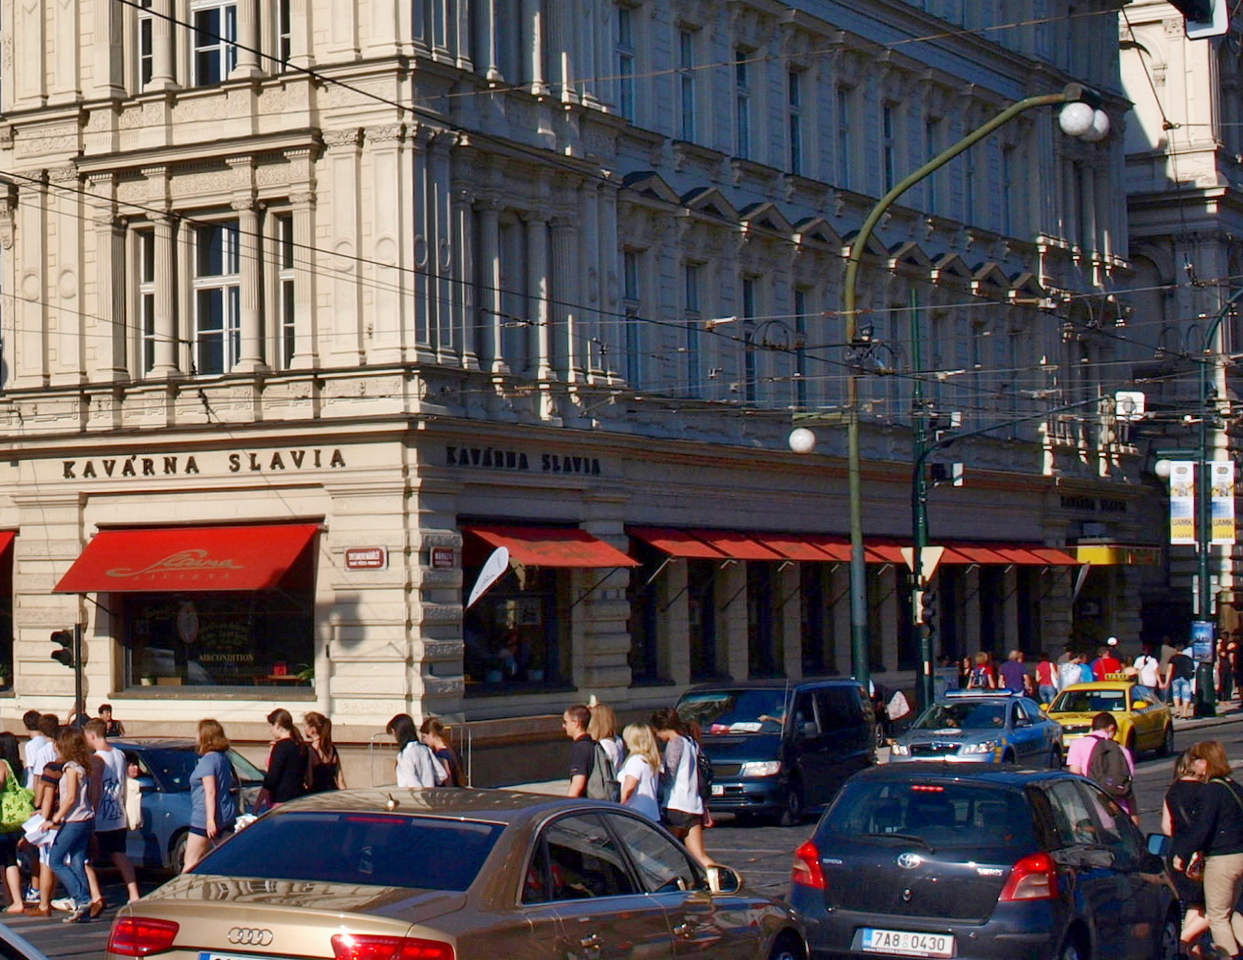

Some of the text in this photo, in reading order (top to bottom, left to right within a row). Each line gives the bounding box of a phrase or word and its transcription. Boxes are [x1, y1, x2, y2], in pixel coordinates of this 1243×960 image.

[62, 449, 346, 478] KAVÁRNA SLAVIA
[446, 446, 602, 476] KAVÁRNA SLAVIA
[199, 653, 254, 662] AIRCONDITION
[875, 932, 901, 947] 7A8
[911, 935, 945, 951] 0430
